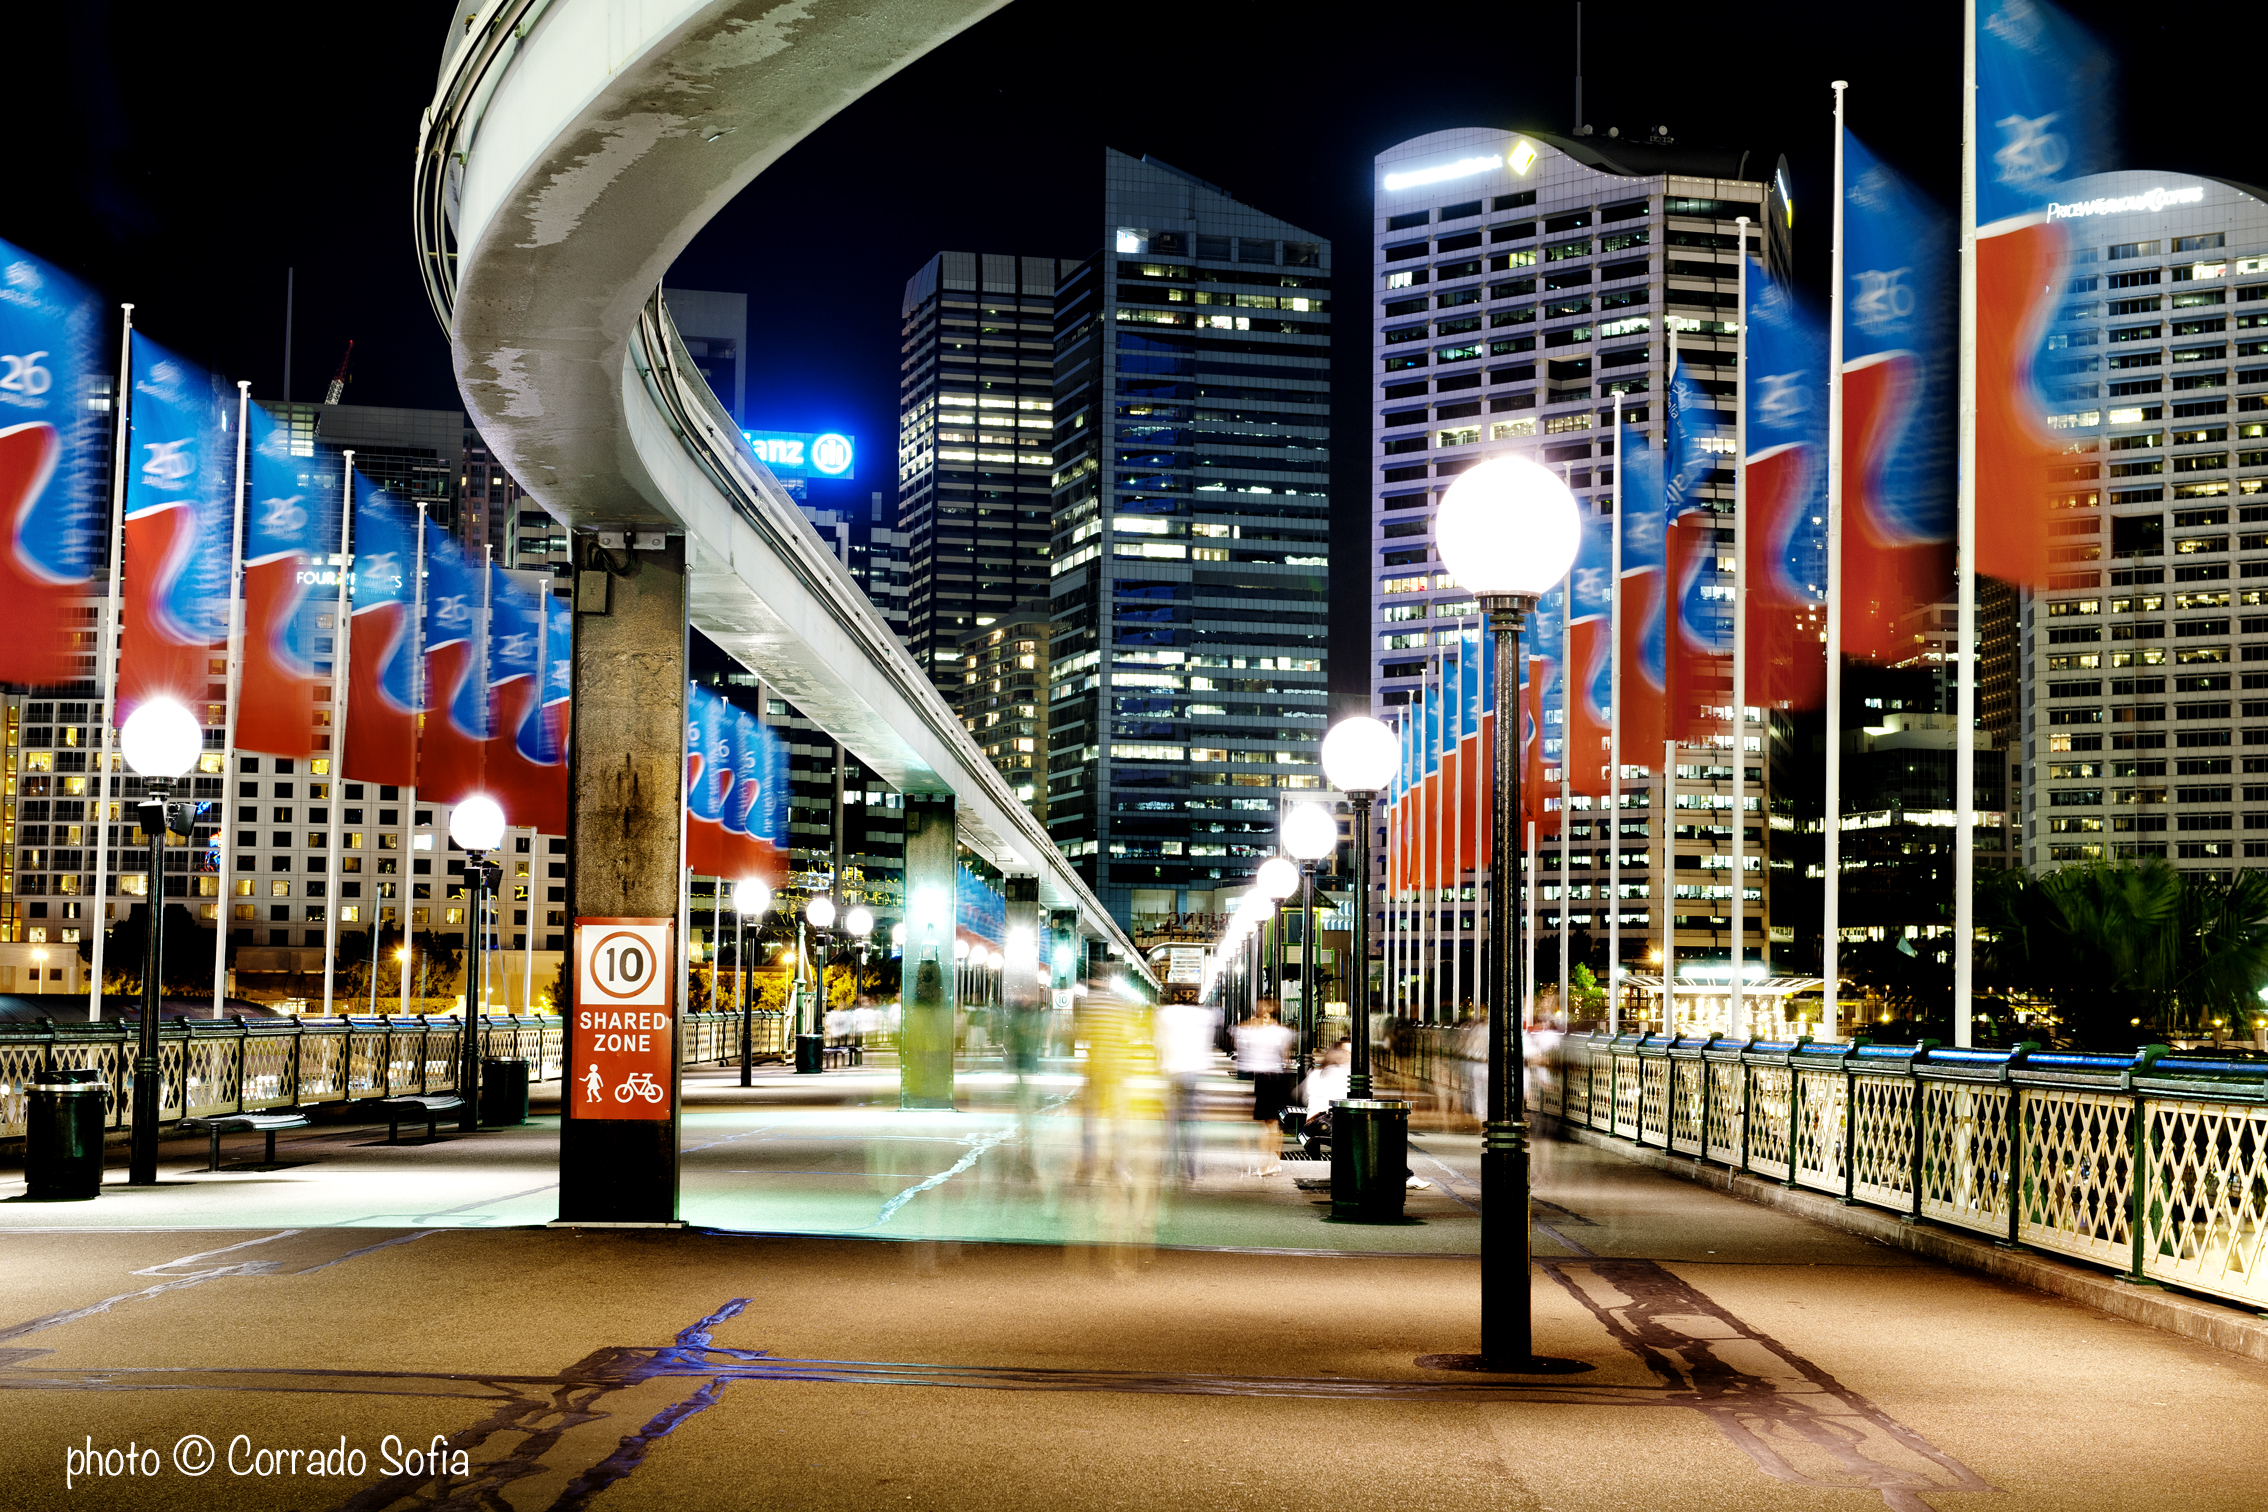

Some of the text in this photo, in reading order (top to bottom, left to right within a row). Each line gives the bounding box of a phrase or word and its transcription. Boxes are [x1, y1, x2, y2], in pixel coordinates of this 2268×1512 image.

[296, 570, 336, 585] FOUR
[607, 947, 644, 982] 10
[1058, 995, 1067, 1004] 10
[579, 1011, 666, 1030] SHARED
[594, 1034, 651, 1052] ZONE
